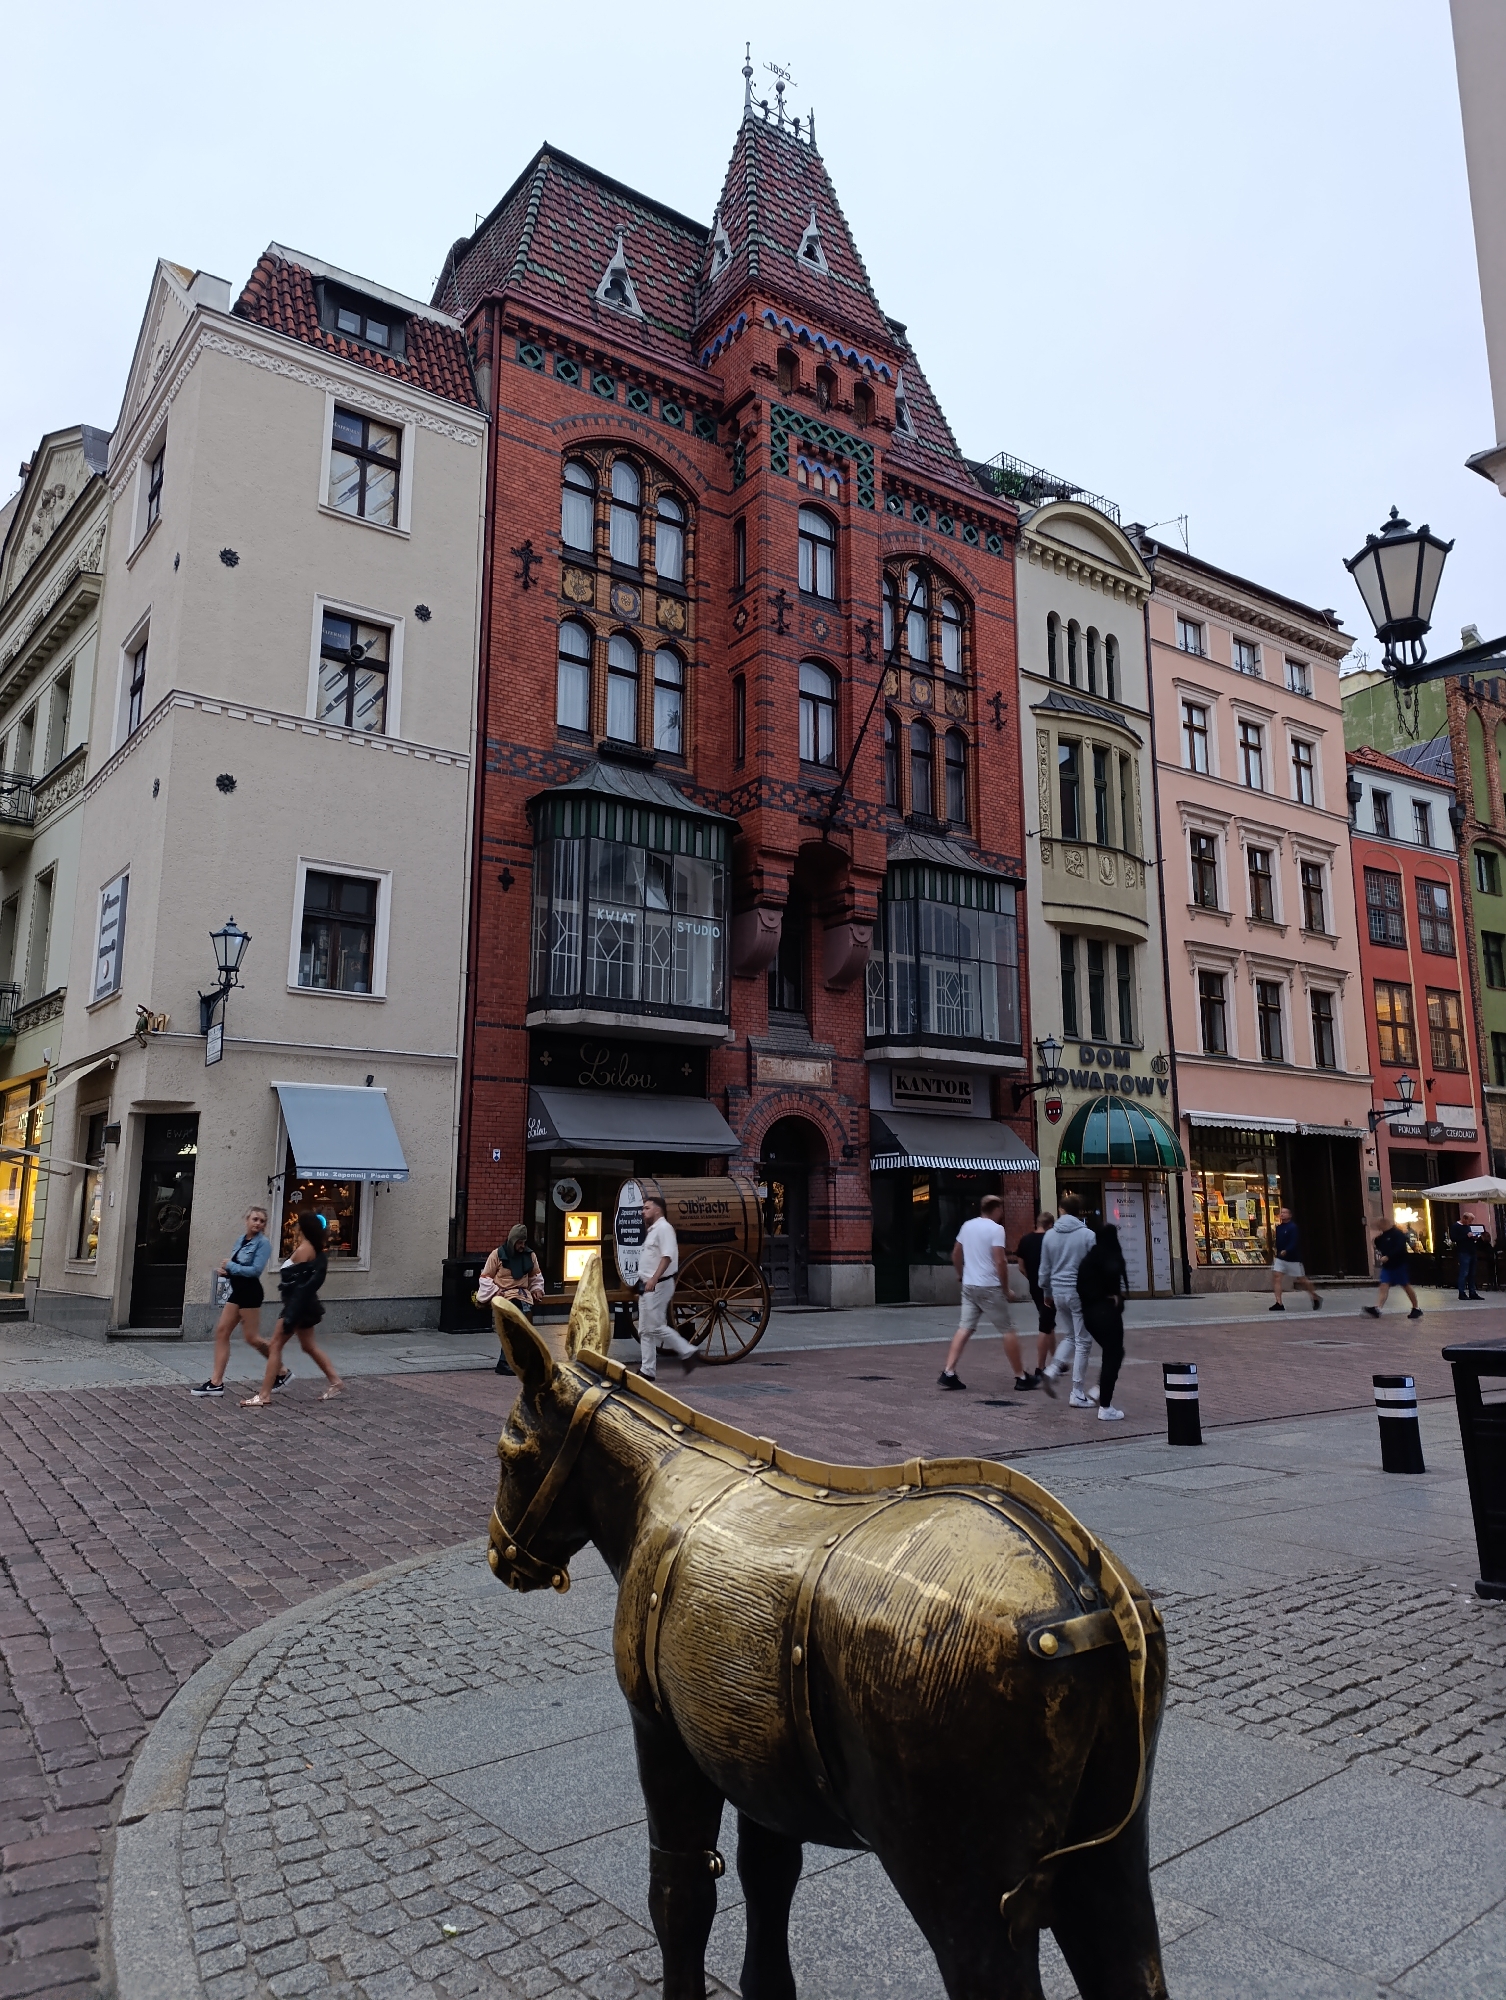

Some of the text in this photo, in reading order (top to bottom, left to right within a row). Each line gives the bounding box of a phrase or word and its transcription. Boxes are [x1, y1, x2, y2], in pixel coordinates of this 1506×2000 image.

[769, 61, 791, 81] 1899
[597, 908, 721, 938] KWIAT STUDIO
[578, 1042, 657, 1089] Lilou
[1079, 1045, 1131, 1069] DOM
[896, 1075, 971, 1096] KANTOR
[1037, 1065, 1169, 1096] TOWAROWY
[1446, 1129, 1476, 1139] CZEKOLADY
[332, 1171, 366, 1180] Zapomnij
[678, 1200, 730, 1215] Olbracht
